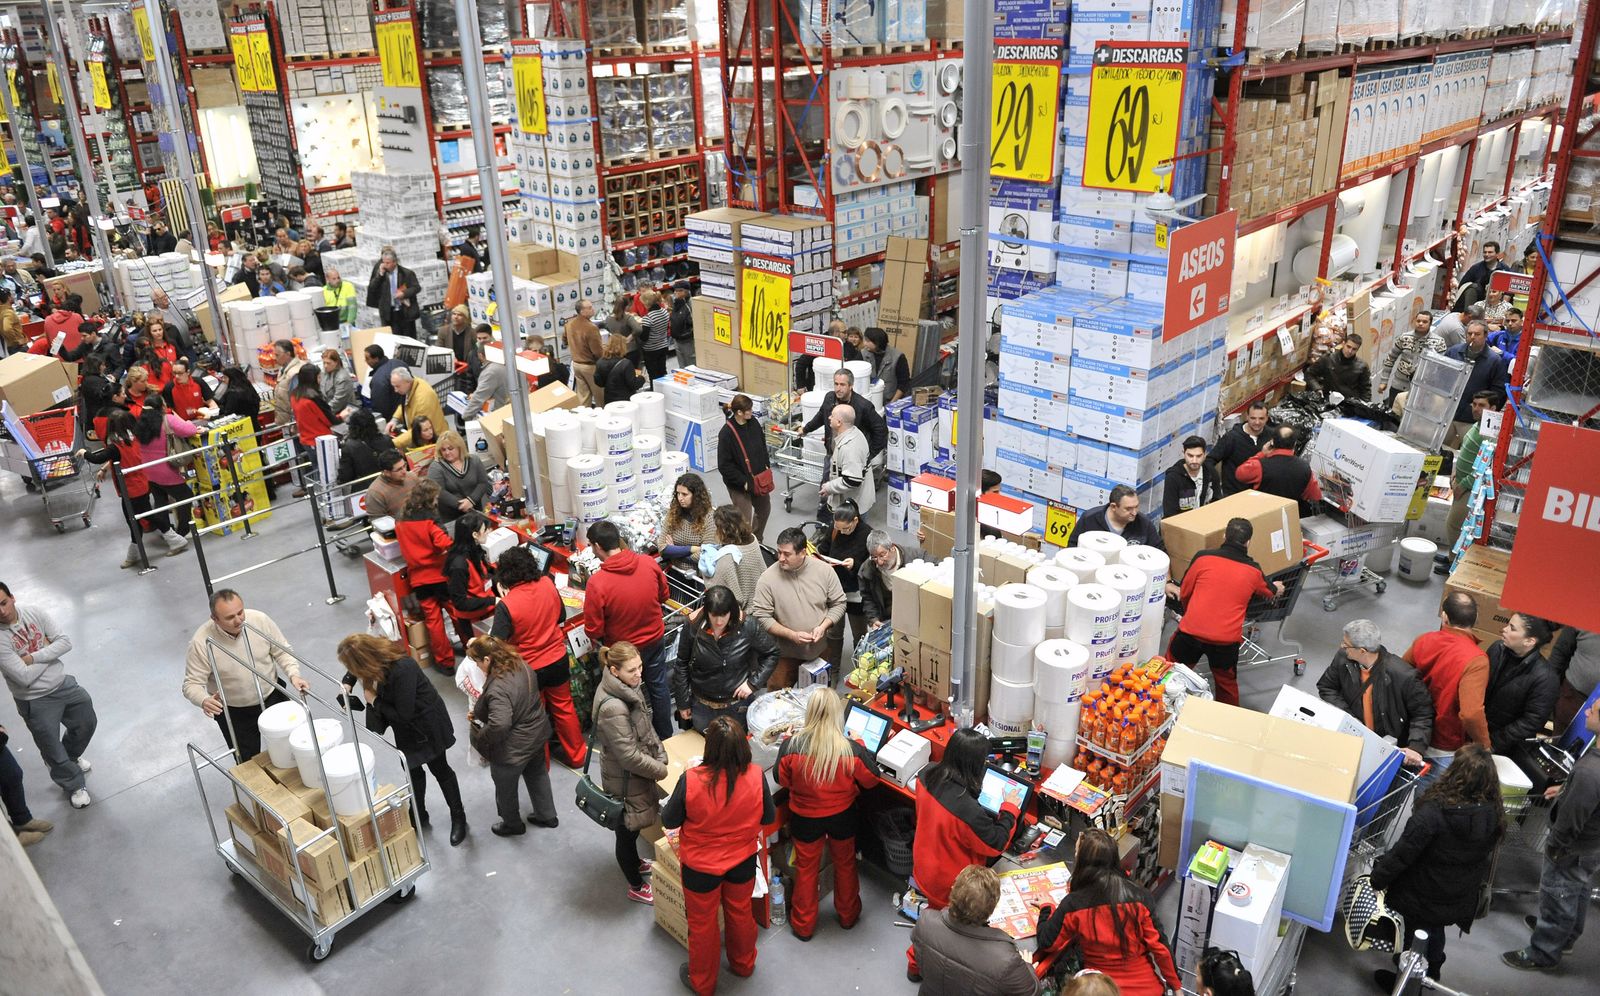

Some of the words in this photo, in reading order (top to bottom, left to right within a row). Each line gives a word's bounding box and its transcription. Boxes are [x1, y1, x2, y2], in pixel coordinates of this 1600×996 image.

[997, 46, 1058, 60] DESCARGAS
[1112, 48, 1183, 63] DESCARGAS
[1097, 68, 1133, 80] VENTILADOR
[992, 81, 1034, 171] 29
[1105, 85, 1149, 184] 69
[1157, 234, 1165, 243] 69
[752, 258, 792, 275] DESCARGAS
[1178, 237, 1225, 283] ASEOS
[749, 284, 787, 353] 10.95
[1341, 454, 1365, 471] FanWorld
[926, 490, 934, 505] 2
[995, 510, 1000, 526] 1
